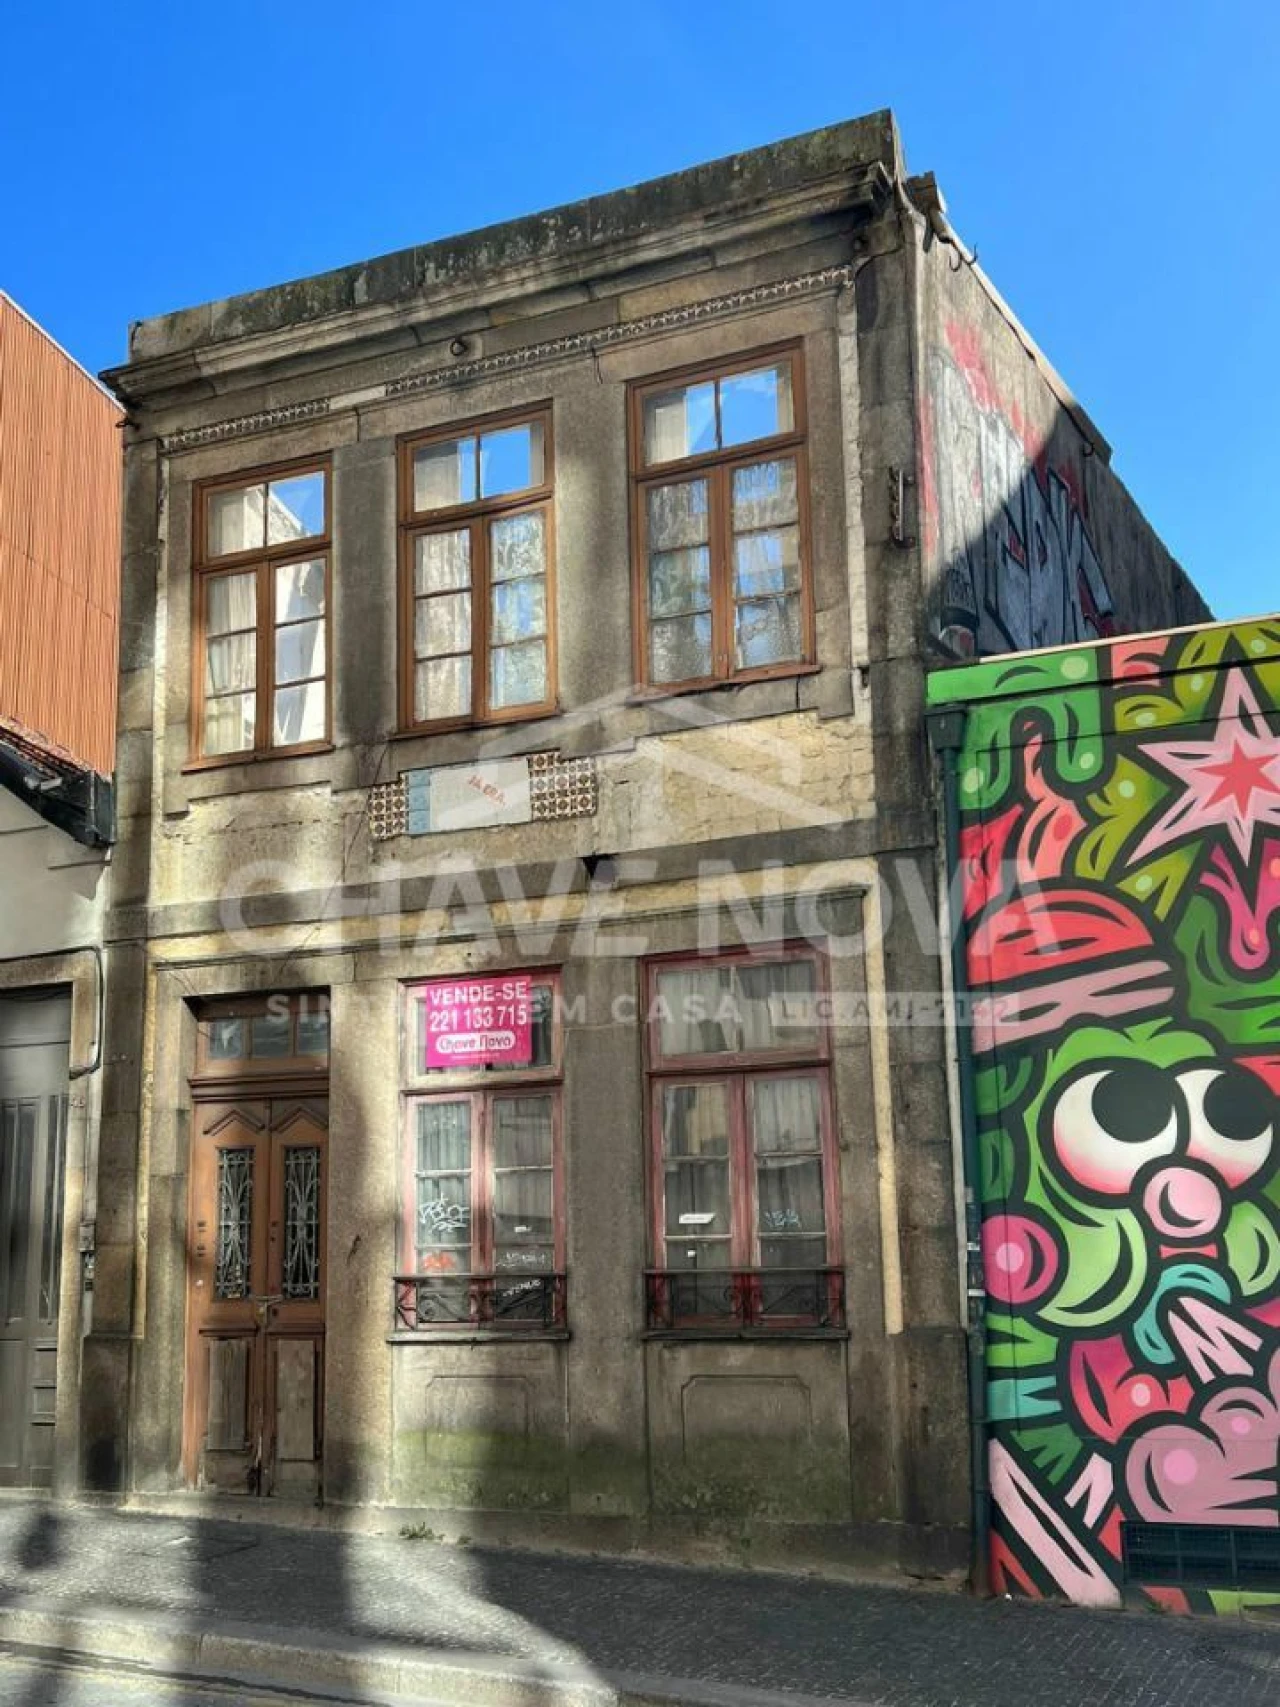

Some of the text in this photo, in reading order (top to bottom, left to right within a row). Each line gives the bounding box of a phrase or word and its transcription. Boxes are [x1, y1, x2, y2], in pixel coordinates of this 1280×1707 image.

[429, 982, 528, 1006] VENDE-SE
[429, 1004, 528, 1032] 221 133 715
